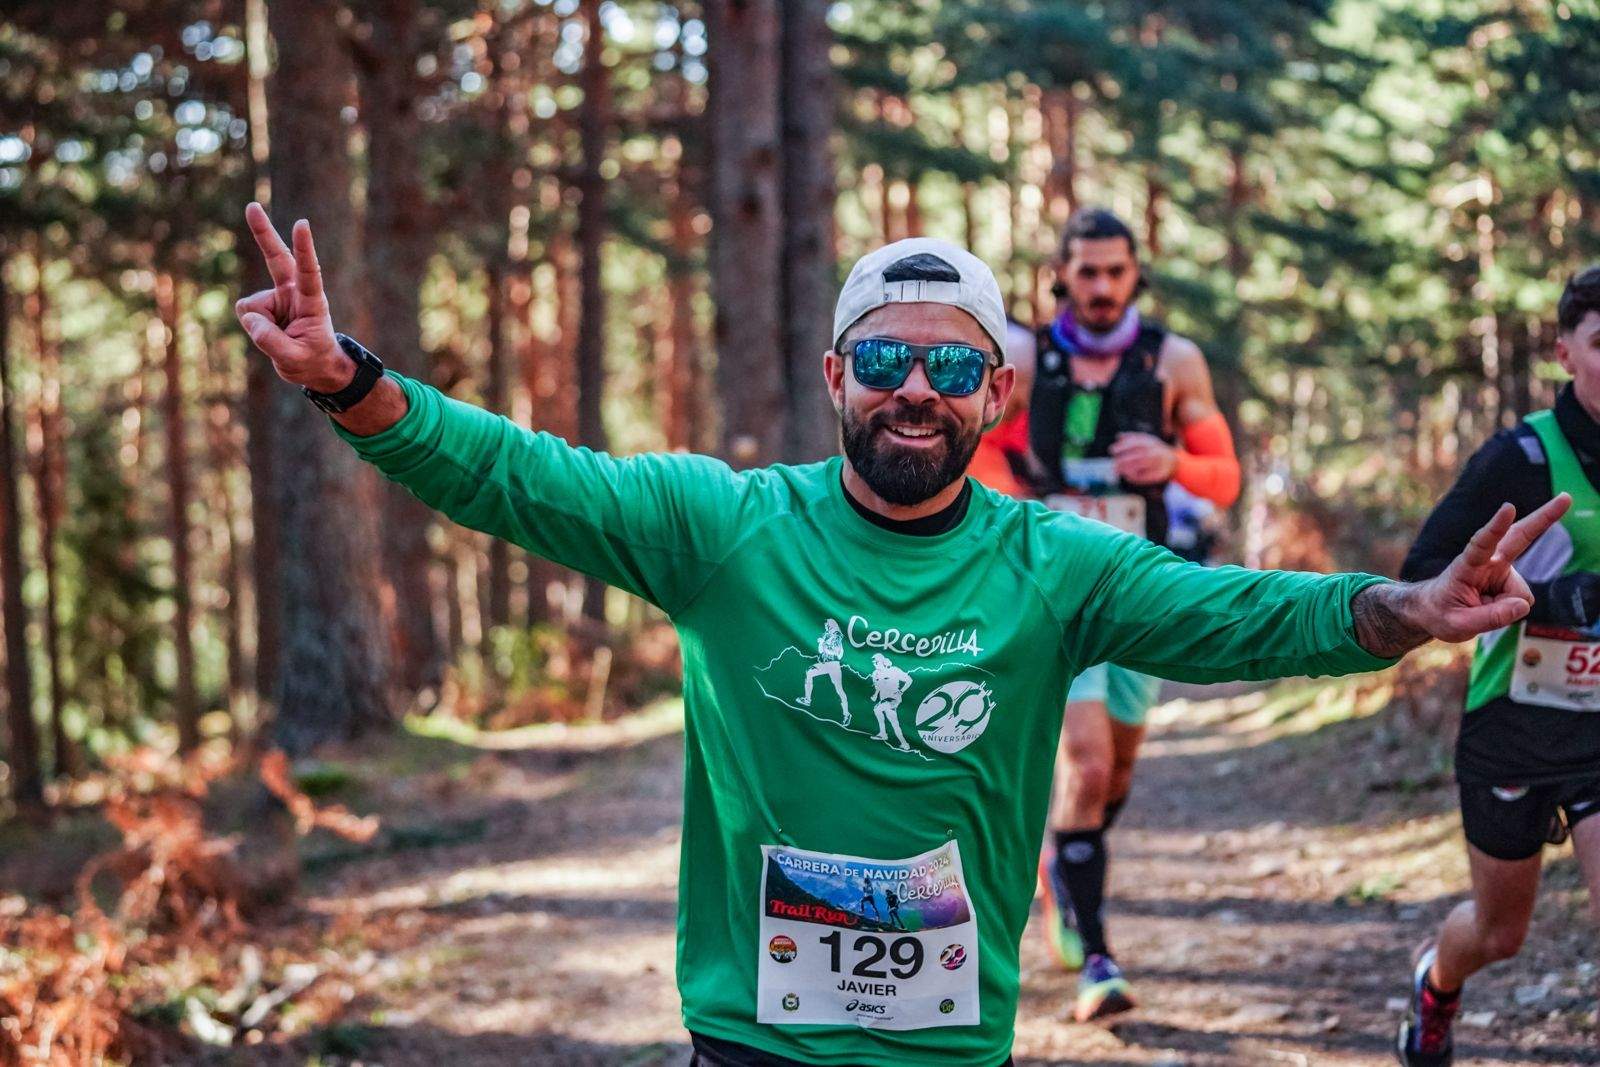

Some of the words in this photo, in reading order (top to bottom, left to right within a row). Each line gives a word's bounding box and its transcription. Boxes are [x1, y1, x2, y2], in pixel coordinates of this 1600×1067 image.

[777, 853, 840, 875] CARRERA
[844, 868, 859, 877] DE
[863, 865, 927, 880] NAVIDAD
[929, 857, 949, 872] 2024
[770, 899, 810, 918] Trail
[814, 905, 859, 925] Run
[819, 930, 925, 980] 129
[837, 979, 897, 996] JAVIER
[858, 1002, 886, 1014] asics
